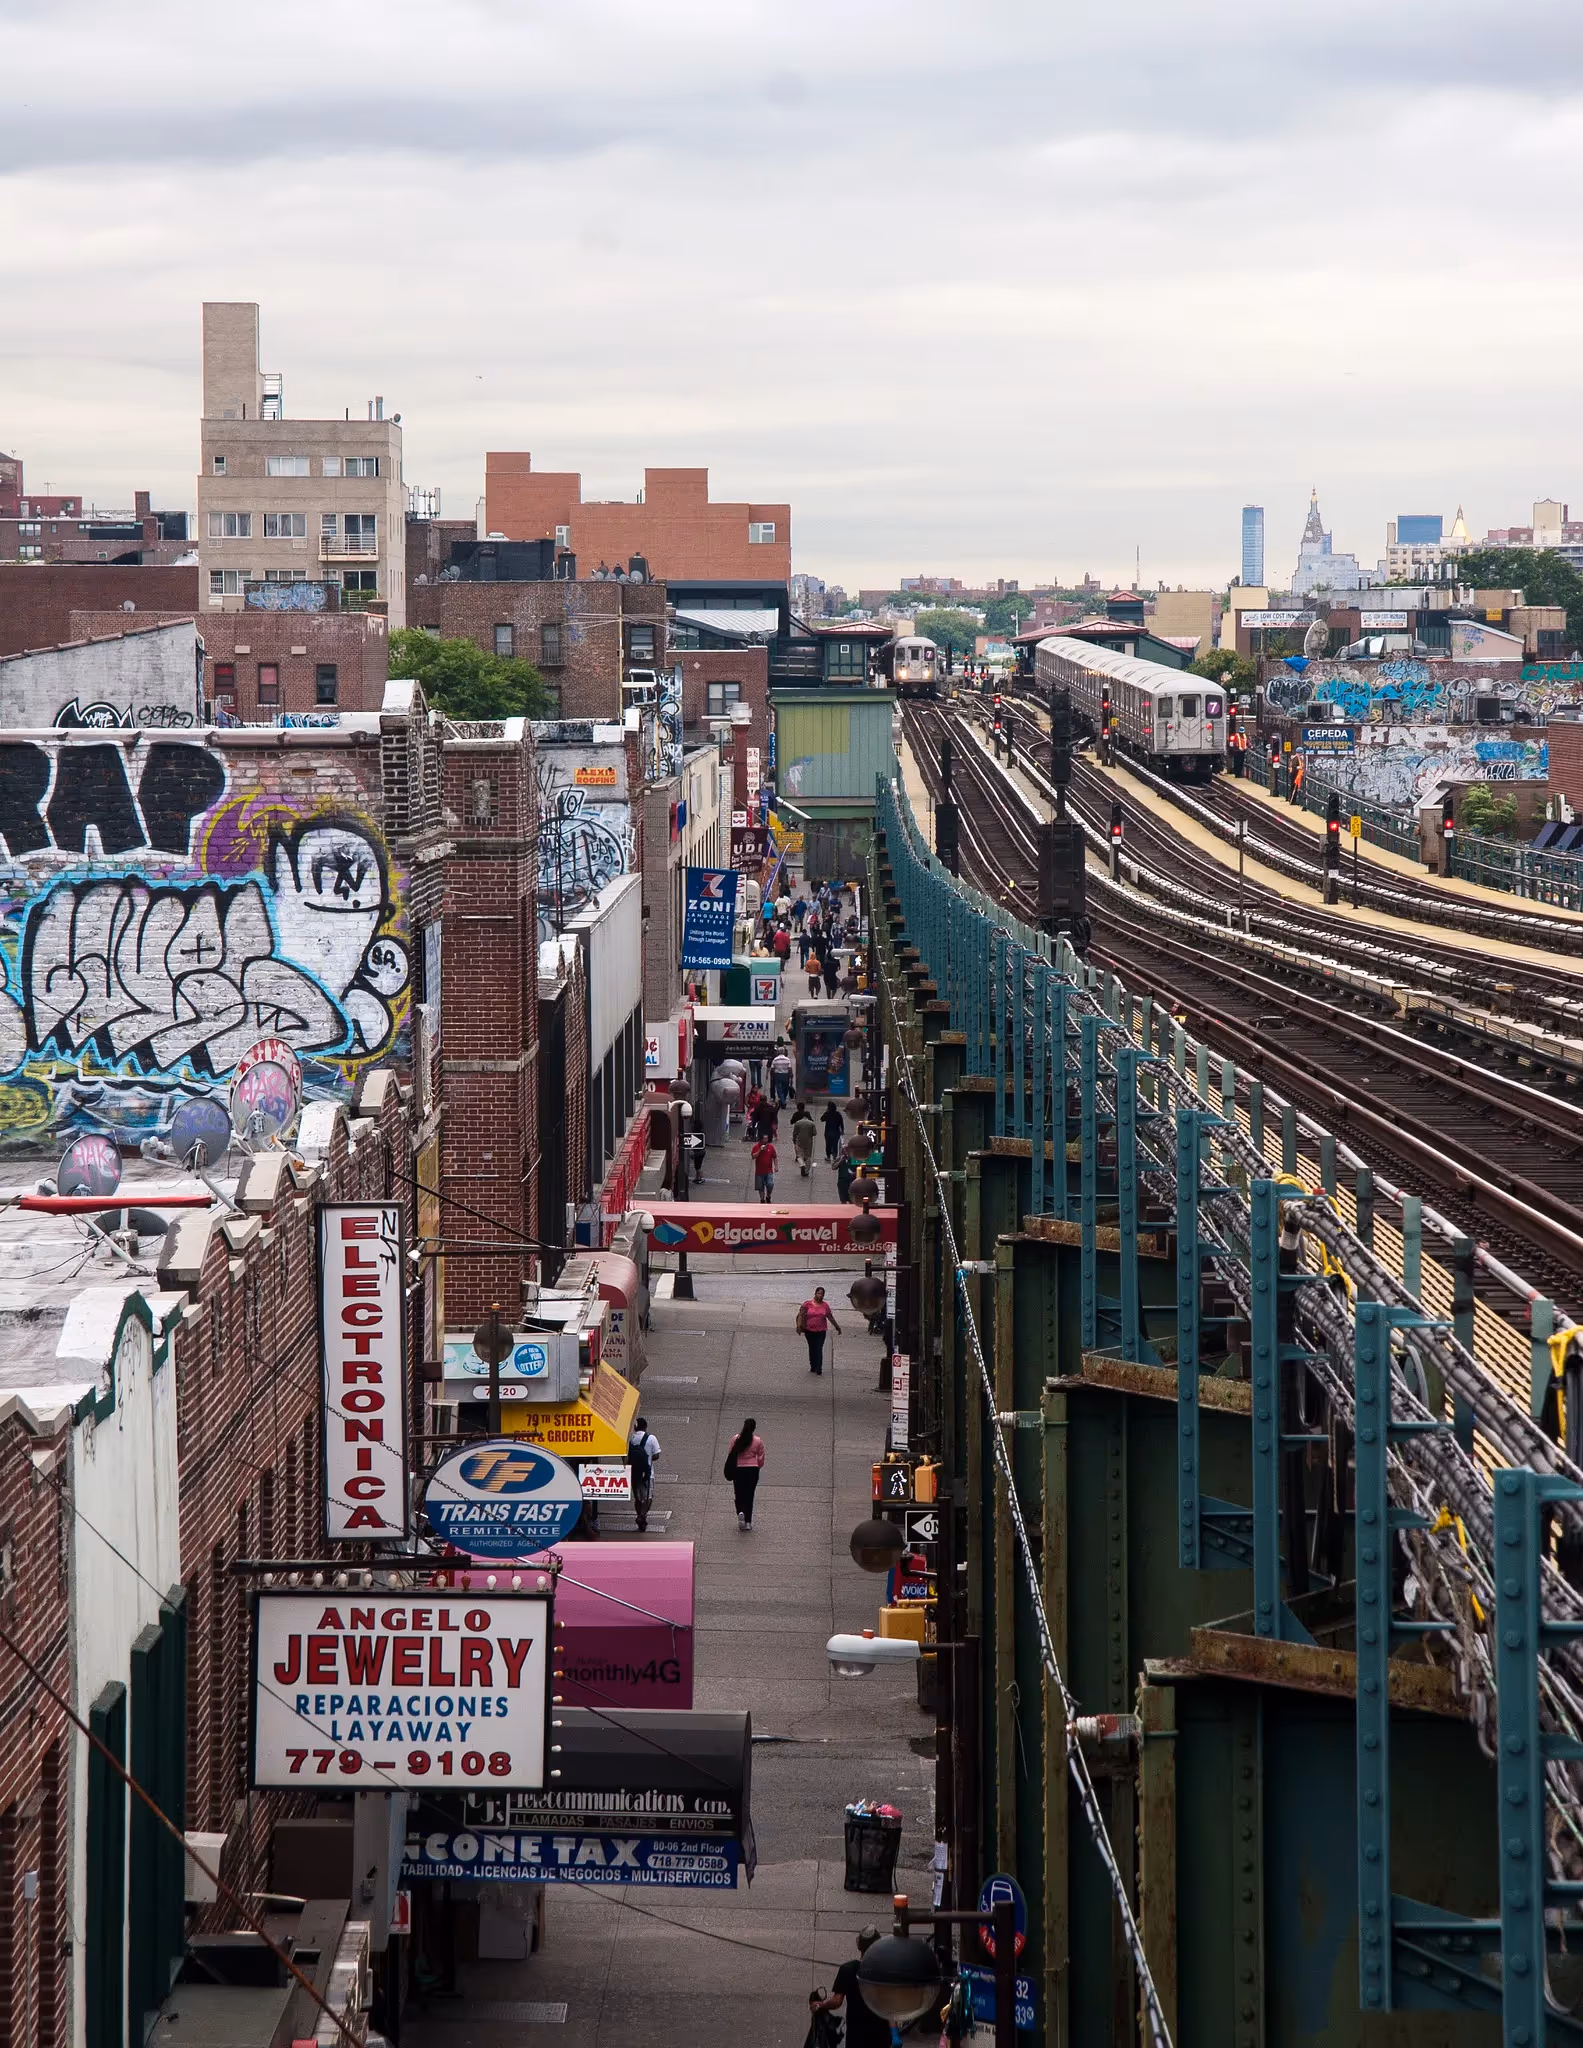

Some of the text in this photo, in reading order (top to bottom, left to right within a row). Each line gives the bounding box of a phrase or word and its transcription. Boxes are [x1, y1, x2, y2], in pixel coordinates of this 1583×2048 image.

[1307, 729, 1348, 738] CEPEDA
[688, 899, 730, 912] ZONI
[683, 955, 731, 965] 718-565-0900
[739, 1022, 769, 1030] ZONI
[691, 1221, 838, 1244] Delgado Travel
[819, 1243, 841, 1252] Tel:
[340, 1216, 388, 1529] ELECTRONICA
[485, 1387, 516, 1396] 7-20
[553, 1414, 593, 1427] STREET
[547, 1430, 595, 1443] GROCERY
[581, 1476, 629, 1488] ATM
[440, 1503, 569, 1522] TRANS FAST
[449, 1526, 561, 1536] REMITTANCE
[316, 1607, 492, 1632] ANGELO
[273, 1634, 534, 1689] JEWELRY
[296, 1694, 510, 1718] REPARACIONES
[331, 1720, 472, 1743] LAYAWAY
[694, 1797, 731, 1814] Corp.
[514, 1814, 715, 1830] LLAMADAS PASAJES ENVIOS
[552, 1836, 641, 1867] TAX
[653, 1840, 725, 1853] 80-06 2nd Floor
[652, 1856, 724, 1869] 718 779 0588
[473, 1866, 537, 1878] LICENCIAS
[540, 1868, 556, 1879] DE
[559, 1868, 621, 1881] NEGOCIOS
[631, 1869, 731, 1884] MULTISERVICIOS
[1016, 1979, 1029, 2000] 32
[1015, 2004, 1027, 2025] 33
